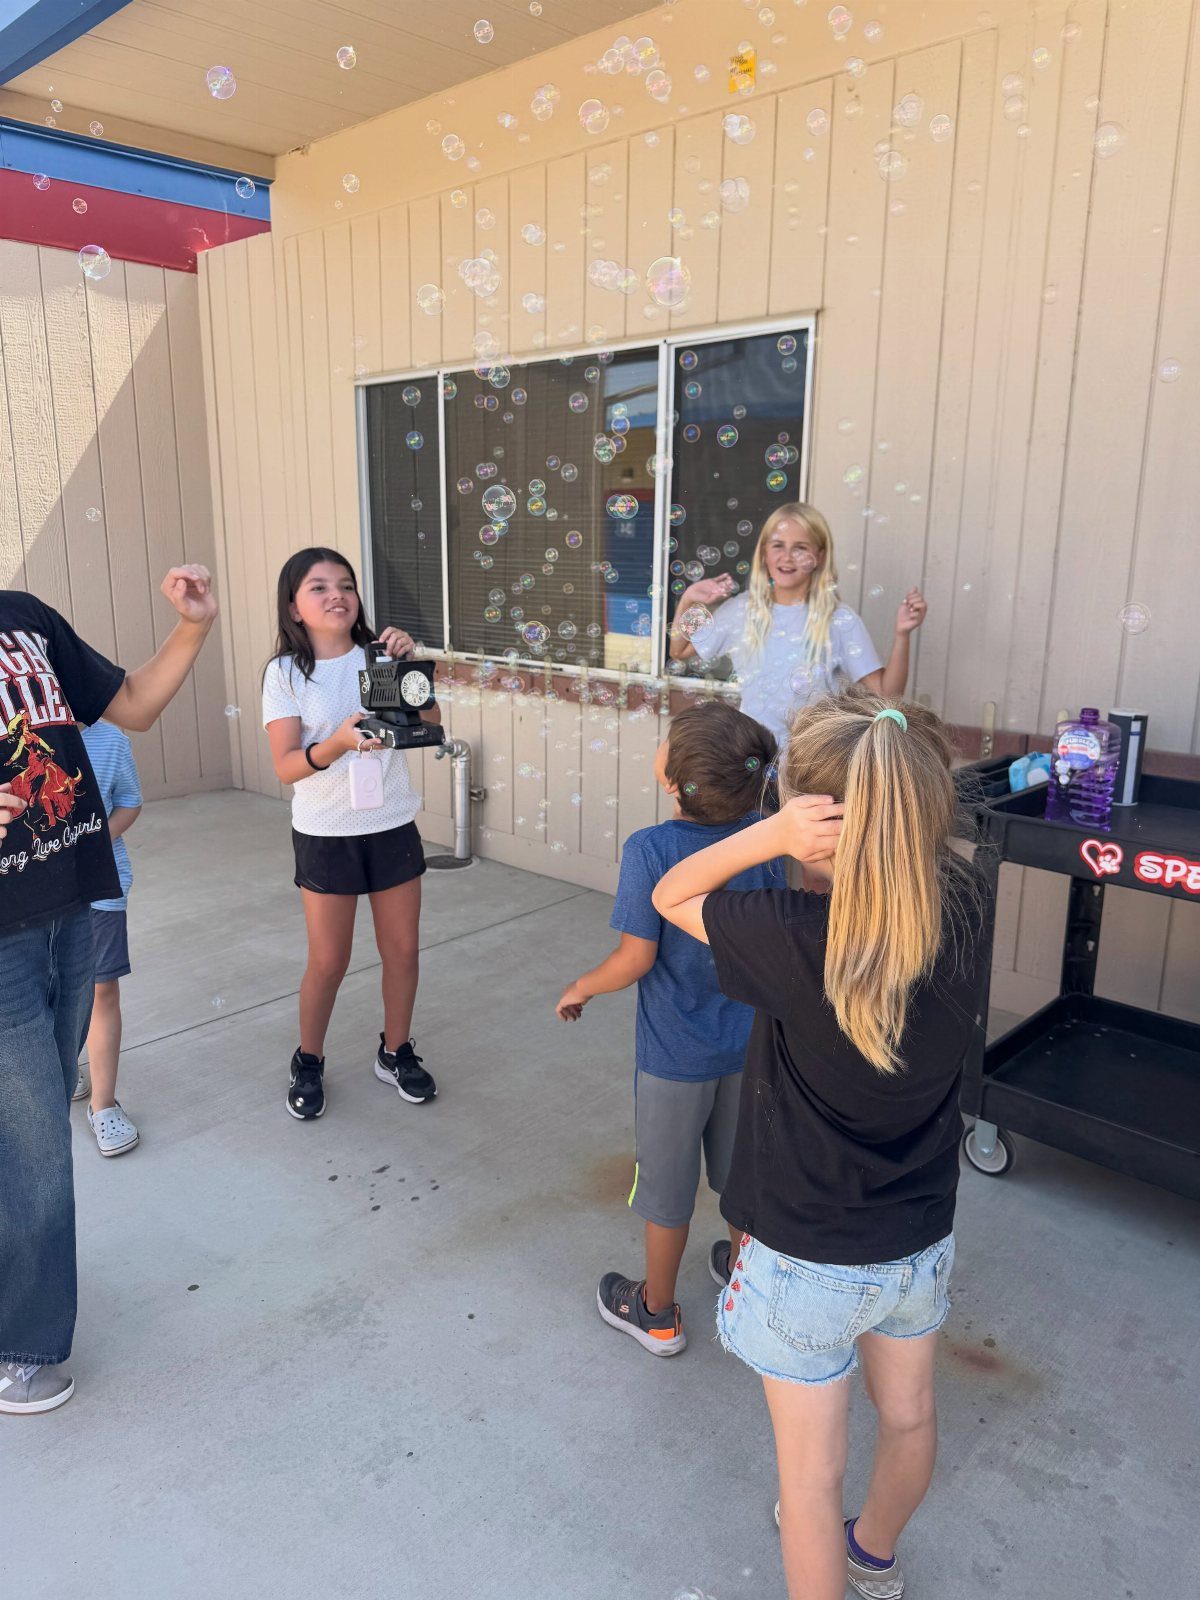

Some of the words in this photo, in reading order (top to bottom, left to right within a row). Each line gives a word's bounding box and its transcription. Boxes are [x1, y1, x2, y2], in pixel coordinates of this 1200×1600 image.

[0, 851, 29, 874] ong
[32, 837, 62, 860] Live
[1137, 853, 1200, 891] SPE
